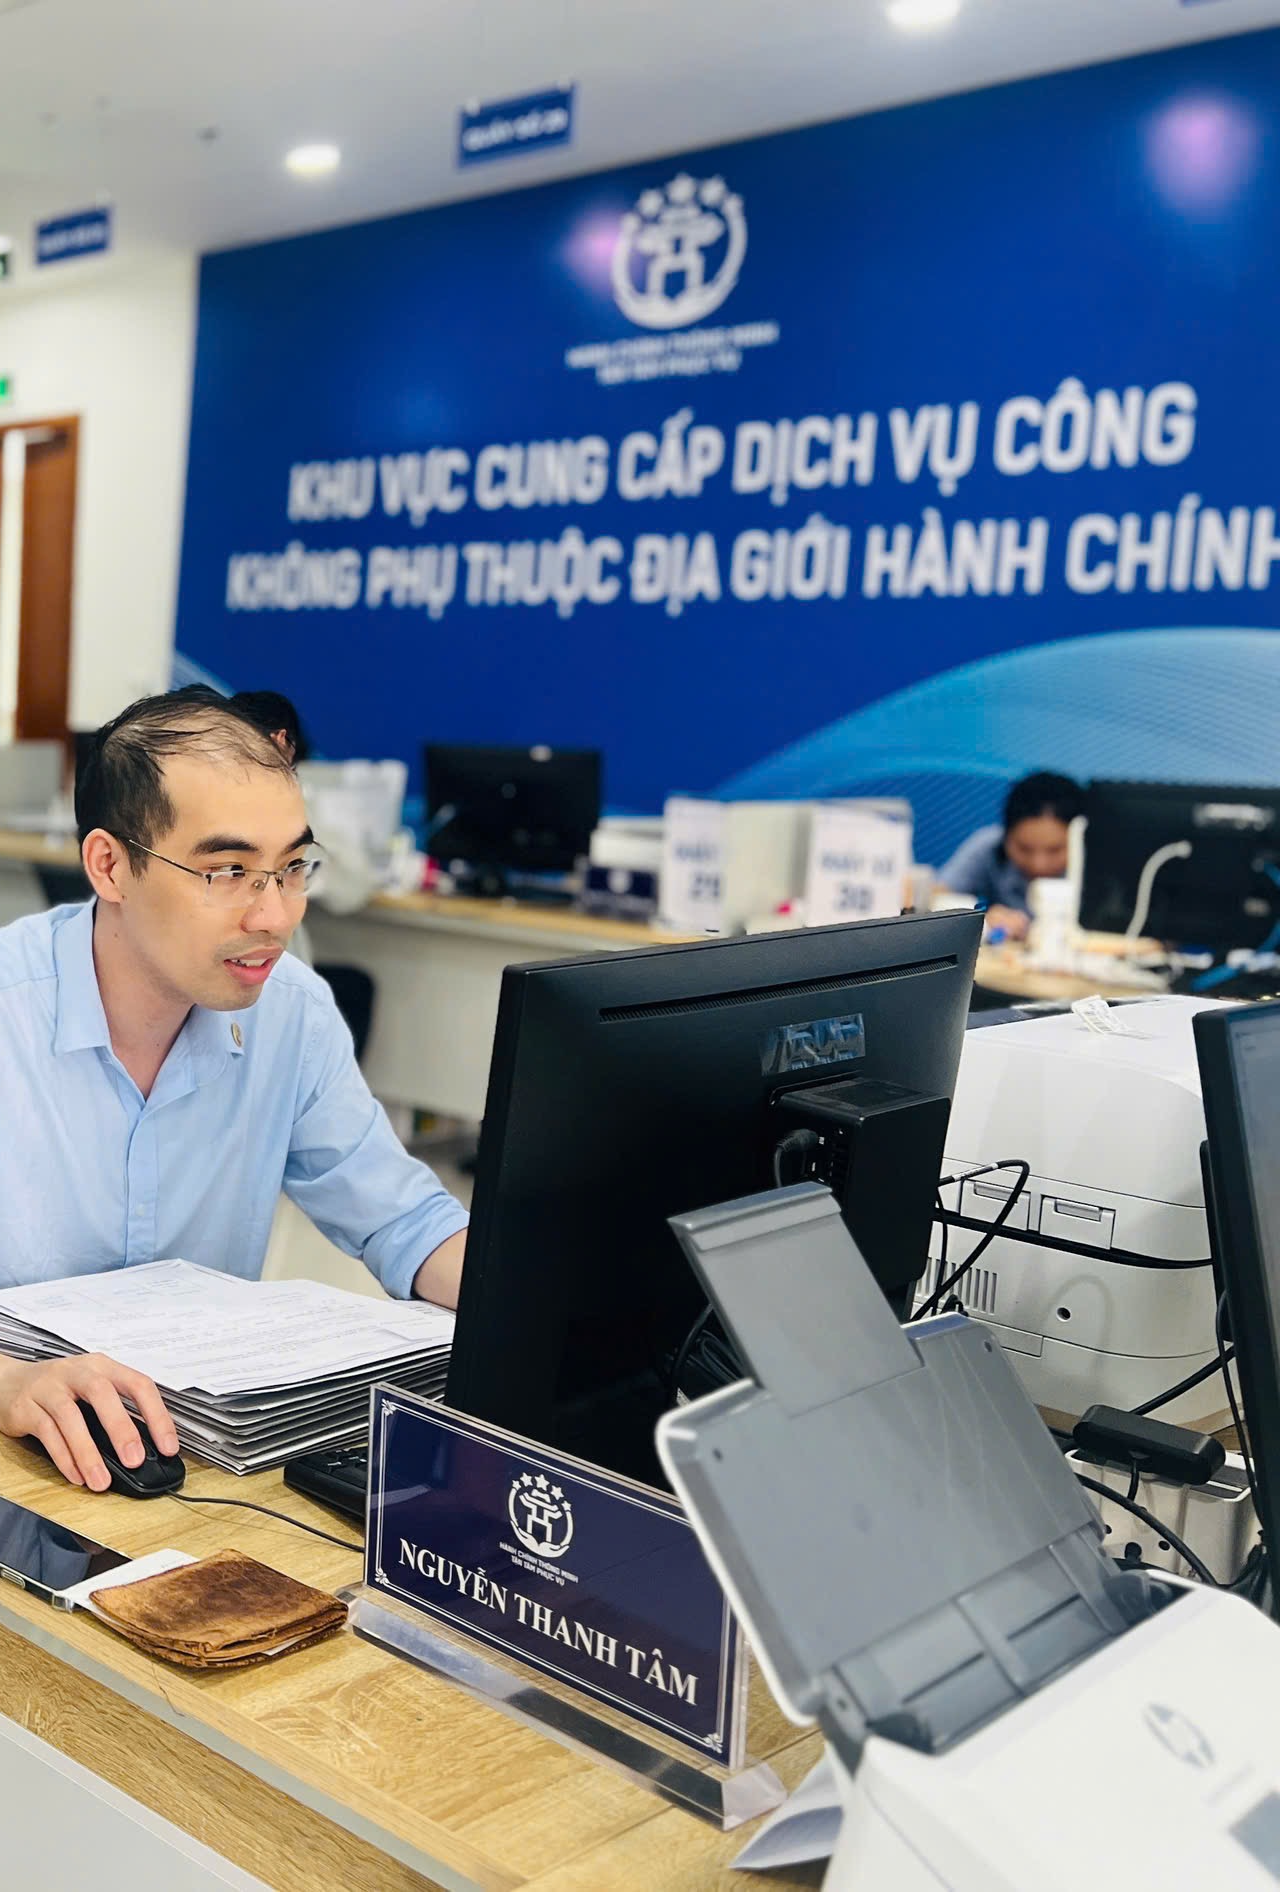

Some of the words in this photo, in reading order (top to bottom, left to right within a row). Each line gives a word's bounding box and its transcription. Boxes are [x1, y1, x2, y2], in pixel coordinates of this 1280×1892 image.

[287, 457, 376, 523] KHU
[380, 447, 469, 528] VỰC
[475, 435, 609, 509] CUNG
[617, 407, 725, 500] CẤP
[732, 412, 878, 506] DỊCH
[888, 400, 980, 497] VỤ
[993, 377, 1197, 477] CÔNG
[226, 540, 362, 611] KHÔNG
[366, 544, 458, 620] PHỤ
[462, 526, 623, 619] THUỘC
[629, 532, 721, 617] ĐỊA
[730, 512, 851, 602] GIỚI
[862, 507, 1049, 599] HÀNH
[1065, 493, 1280, 594] CHÍNH
[399, 1538, 508, 1615] NGUYỄN
[514, 1593, 618, 1668] THANH
[625, 1647, 699, 1706] TÂM
